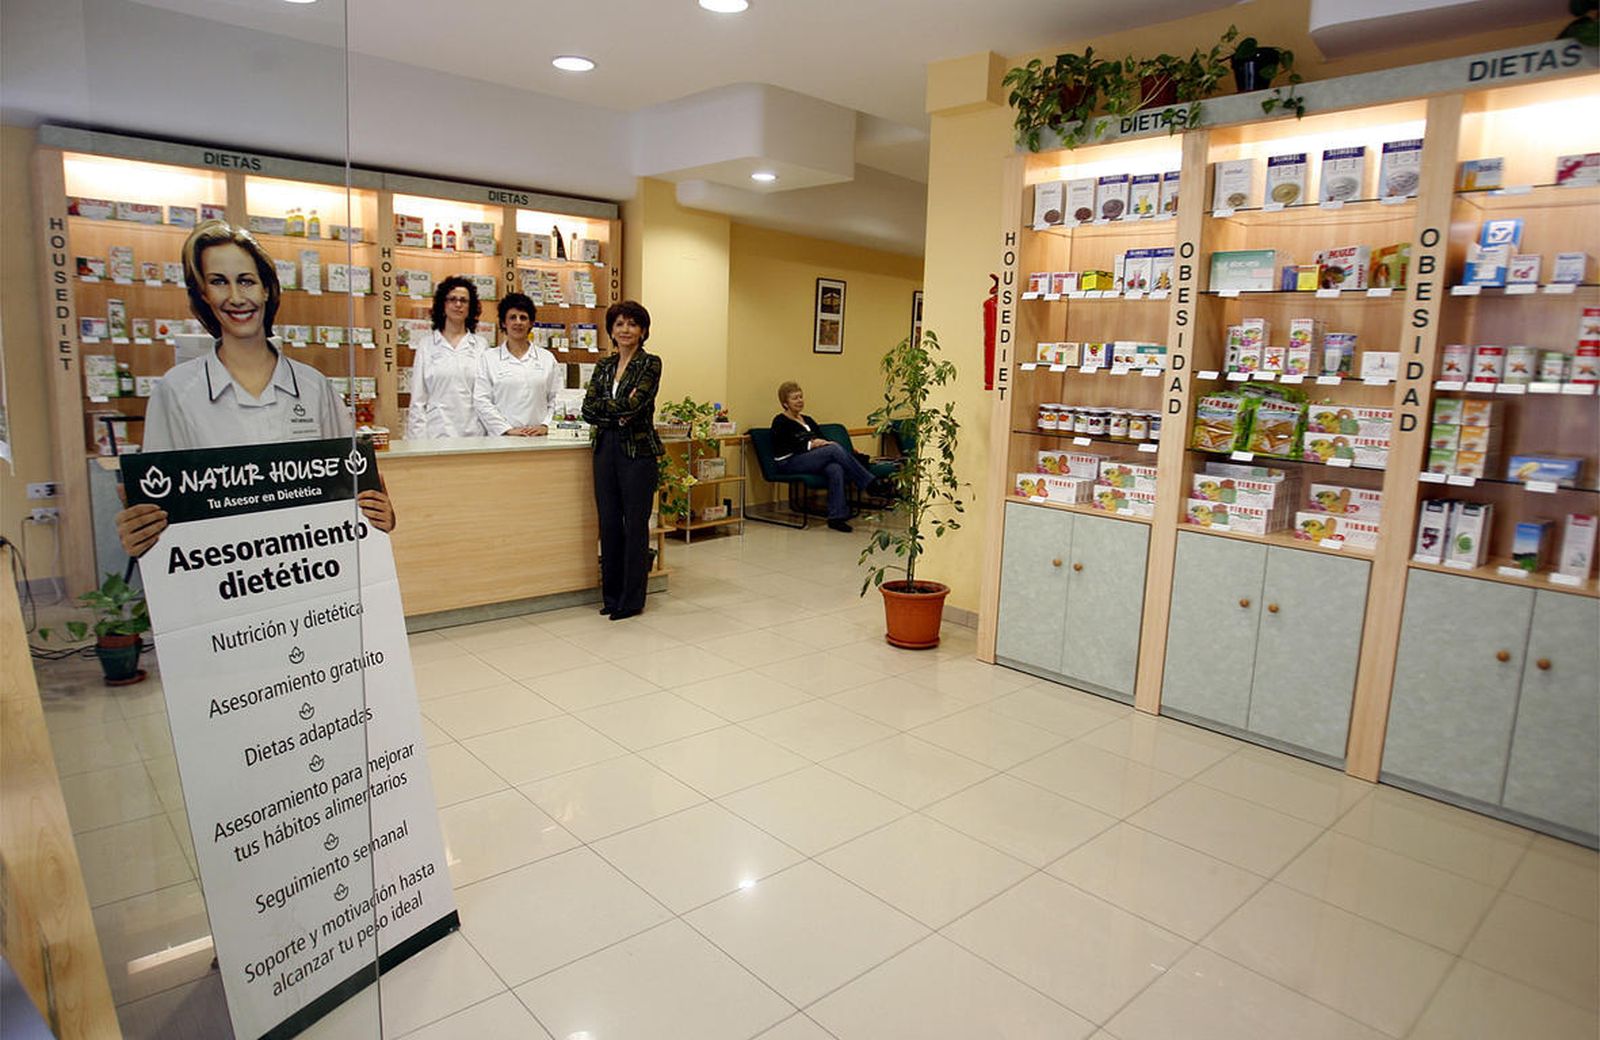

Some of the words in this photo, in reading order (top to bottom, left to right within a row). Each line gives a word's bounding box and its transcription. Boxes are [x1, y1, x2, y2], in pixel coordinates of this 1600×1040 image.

[1469, 44, 1584, 82] DIETAS
[1120, 109, 1188, 134] DIETAS
[204, 151, 262, 172] DIETAS
[488, 190, 529, 206] DIETAS
[49, 217, 73, 371] HOUSEDIET
[381, 247, 393, 372] HOUSEDIET
[998, 231, 1016, 401] HOUSEDIET
[1168, 241, 1195, 415] OBESIDAD
[1400, 228, 1440, 433] OBESIDAD
[1359, 410, 1393, 419] FIBROK
[1354, 438, 1391, 448] FIBROK
[179, 463, 265, 496] NATUR
[269, 457, 341, 485] HOUSE
[207, 497, 221, 510] Tu
[222, 493, 260, 509] Asesor
[262, 493, 275, 504] en
[276, 486, 323, 501] Dietética
[1136, 467, 1157, 476] FIBRO
[1360, 492, 1381, 501] FIBR
[168, 519, 369, 575] Asesoramiento
[1345, 521, 1380, 533] FIBROK
[218, 558, 341, 601] dietético
[211, 618, 288, 654] Nutrición
[289, 618, 299, 637] y
[303, 601, 364, 630] dietética
[208, 667, 327, 719] Asesoramiento
[330, 650, 385, 684] gratuito
[244, 738, 296, 768] Dietas
[299, 707, 374, 746] adaptadas
[213, 781, 329, 843] Asesoramiento
[331, 765, 363, 792] para
[367, 742, 416, 774] mejorar
[233, 841, 261, 863] tus
[263, 811, 322, 849] hábitos
[324, 770, 408, 820] alimentarios
[254, 853, 350, 914] Seguimiento
[352, 820, 409, 863] semanal
[244, 937, 307, 984] Soporte
[309, 927, 318, 950] y
[321, 879, 398, 937] motivación
[399, 861, 436, 891] hasta
[272, 947, 336, 997] alcanzar
[338, 936, 354, 954] tu
[357, 917, 389, 946] peso
[391, 890, 424, 919] ideal
